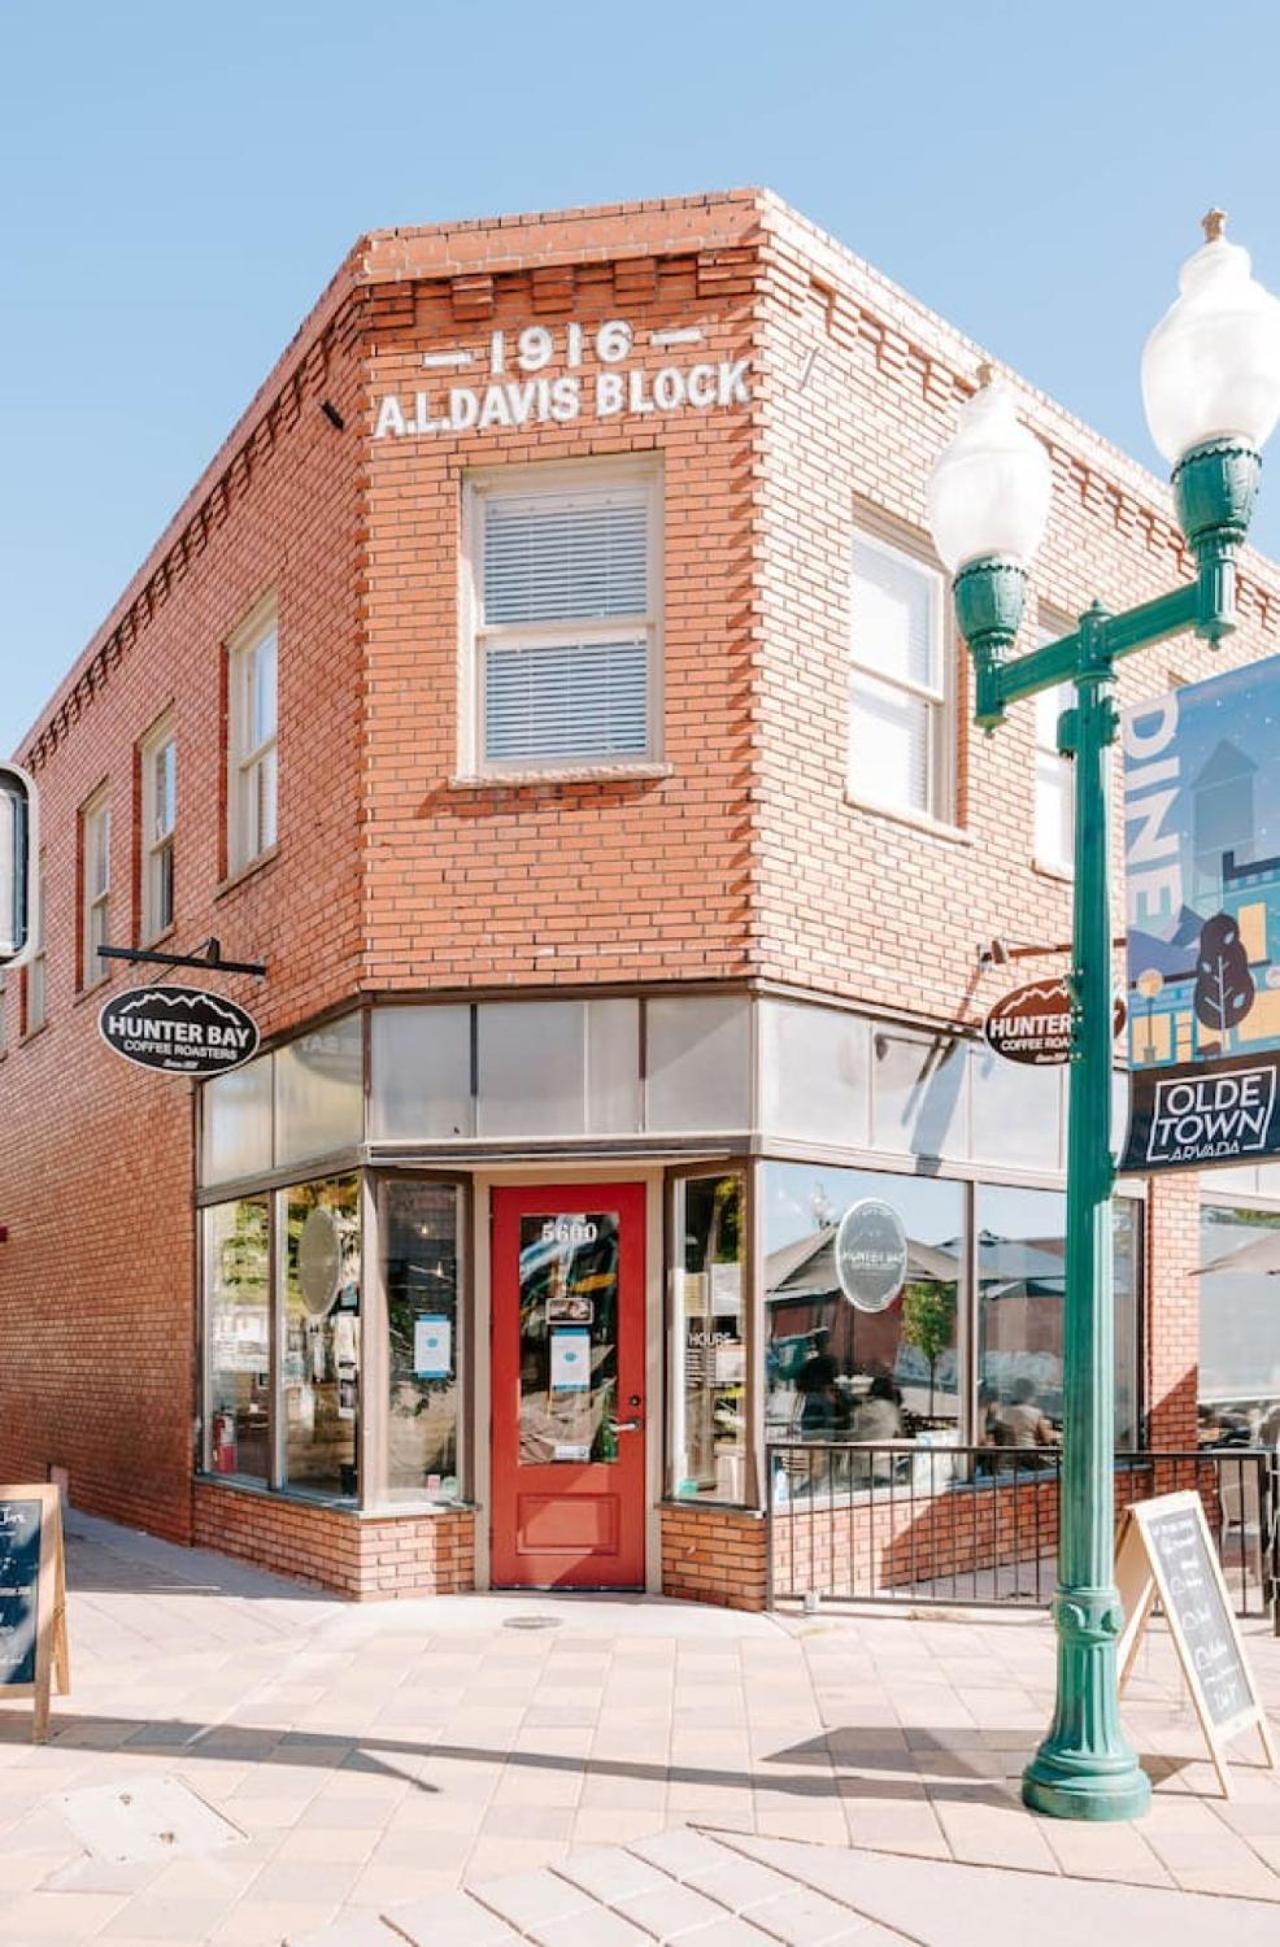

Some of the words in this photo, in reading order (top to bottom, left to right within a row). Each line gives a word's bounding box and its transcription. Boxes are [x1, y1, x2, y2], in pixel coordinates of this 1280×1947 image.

[491, 319, 634, 375] 1916
[596, 358, 754, 418] BLOCK
[1122, 690, 1183, 942] DINE
[108, 1015, 202, 1044] HUNTER
[208, 1025, 250, 1048] BAY
[990, 1013, 1072, 1039] HUNTER
[1001, 1037, 1043, 1051] COFFEE
[124, 1039, 172, 1055] COFFEE
[174, 1044, 237, 1061] ROASTERS
[1166, 1074, 1263, 1116] OLDE
[1157, 1106, 1266, 1145] TOWN
[1167, 1138, 1241, 1162] ARVADA
